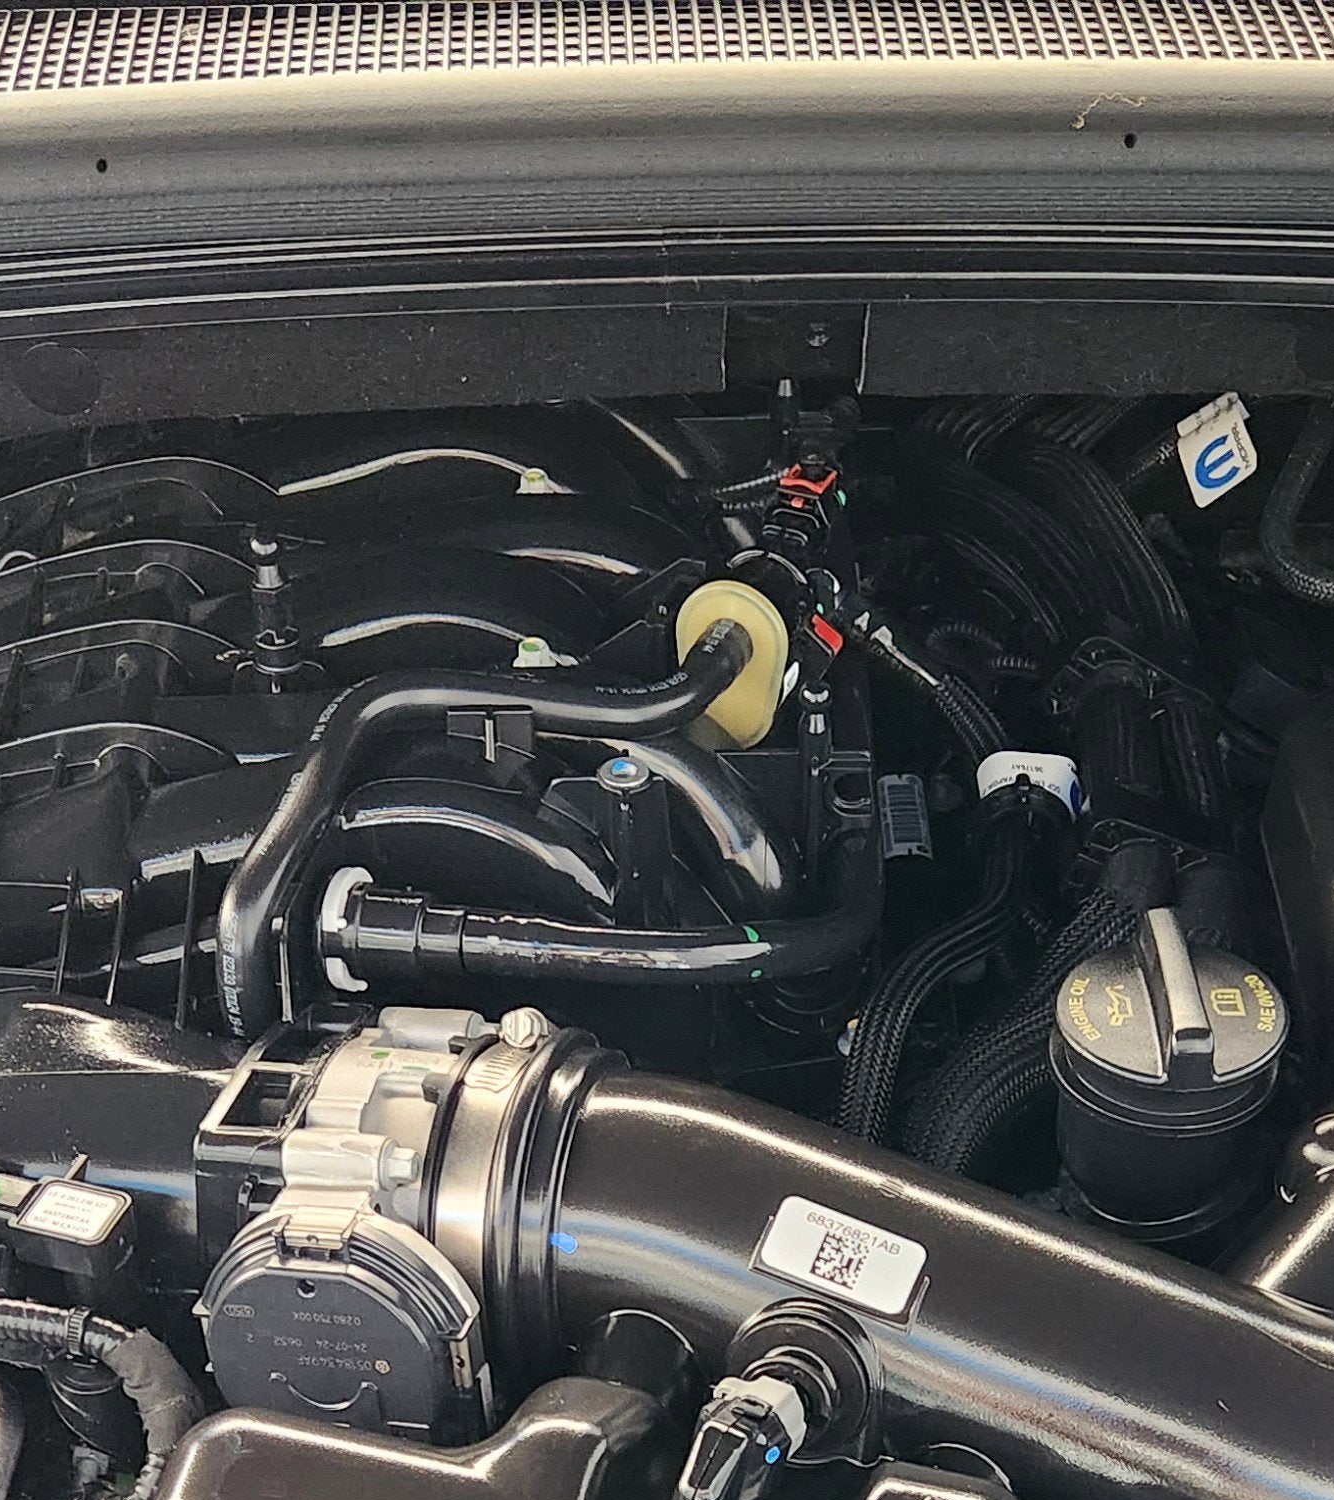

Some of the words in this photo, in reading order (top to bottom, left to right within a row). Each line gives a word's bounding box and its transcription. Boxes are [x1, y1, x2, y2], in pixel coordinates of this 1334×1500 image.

[1231, 422, 1252, 469] MOPAR
[1071, 976, 1090, 996] OIL
[1068, 995, 1102, 1042] ENGINE
[1258, 1007, 1276, 1032] SAE
[807, 1211, 901, 1255] 68376821AB
